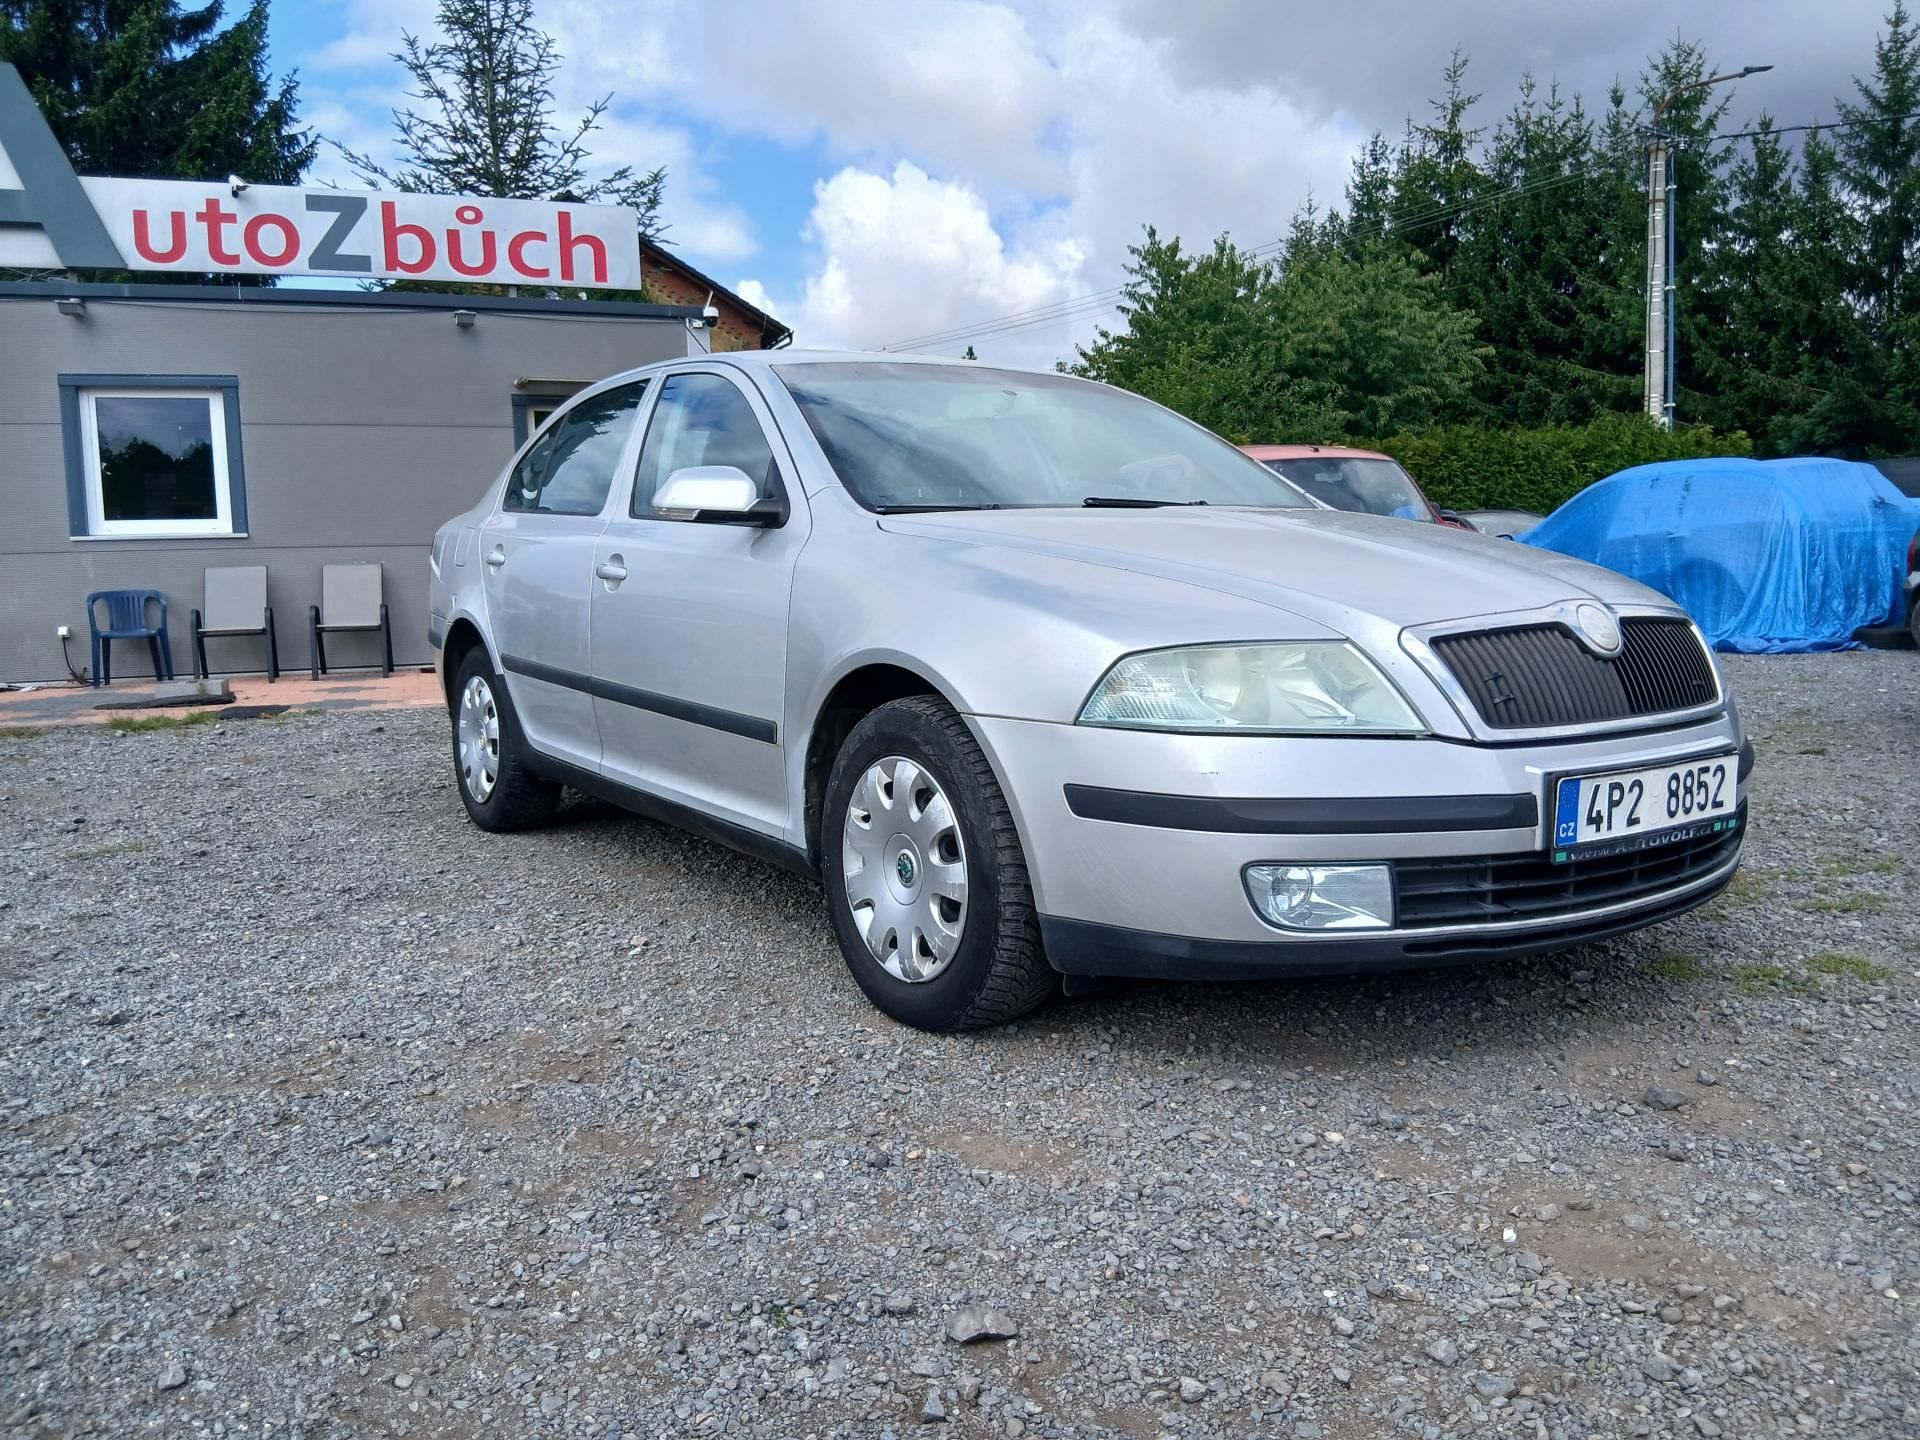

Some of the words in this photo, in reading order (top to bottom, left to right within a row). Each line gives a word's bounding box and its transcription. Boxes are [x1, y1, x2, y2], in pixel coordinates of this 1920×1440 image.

[1585, 778, 1644, 833] 4P2
[1666, 764, 1726, 818] 8852
[1559, 821, 1575, 838] CZ
